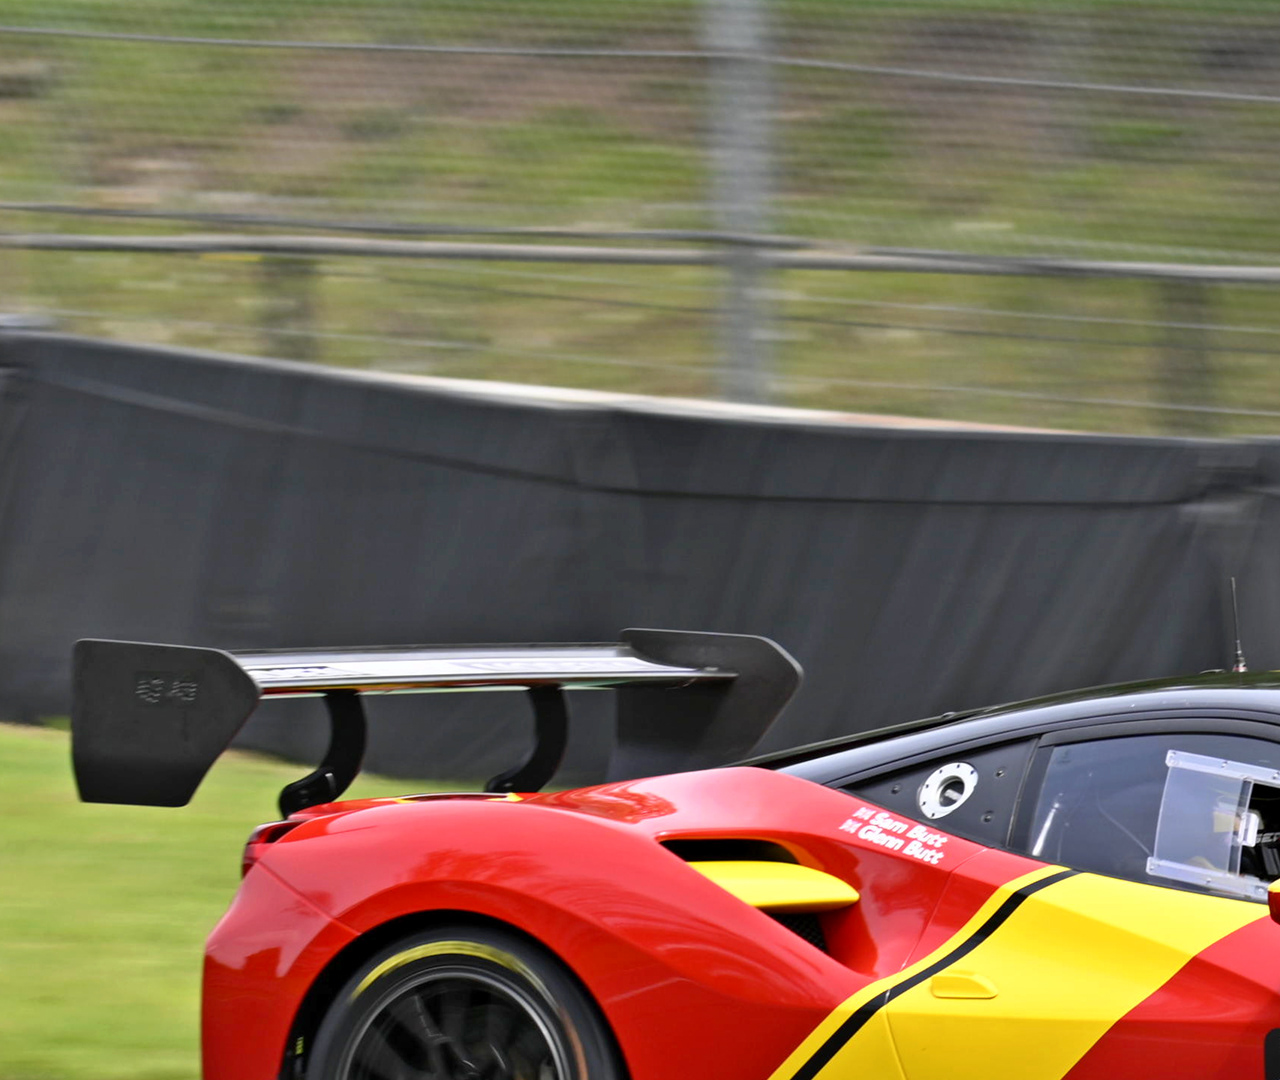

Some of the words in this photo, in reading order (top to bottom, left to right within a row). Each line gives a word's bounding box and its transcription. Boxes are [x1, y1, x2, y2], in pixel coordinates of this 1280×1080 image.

[858, 825, 905, 851] Glenn
[902, 840, 945, 865] Butt
[869, 812, 909, 834] Sam
[905, 824, 948, 848] Butt
